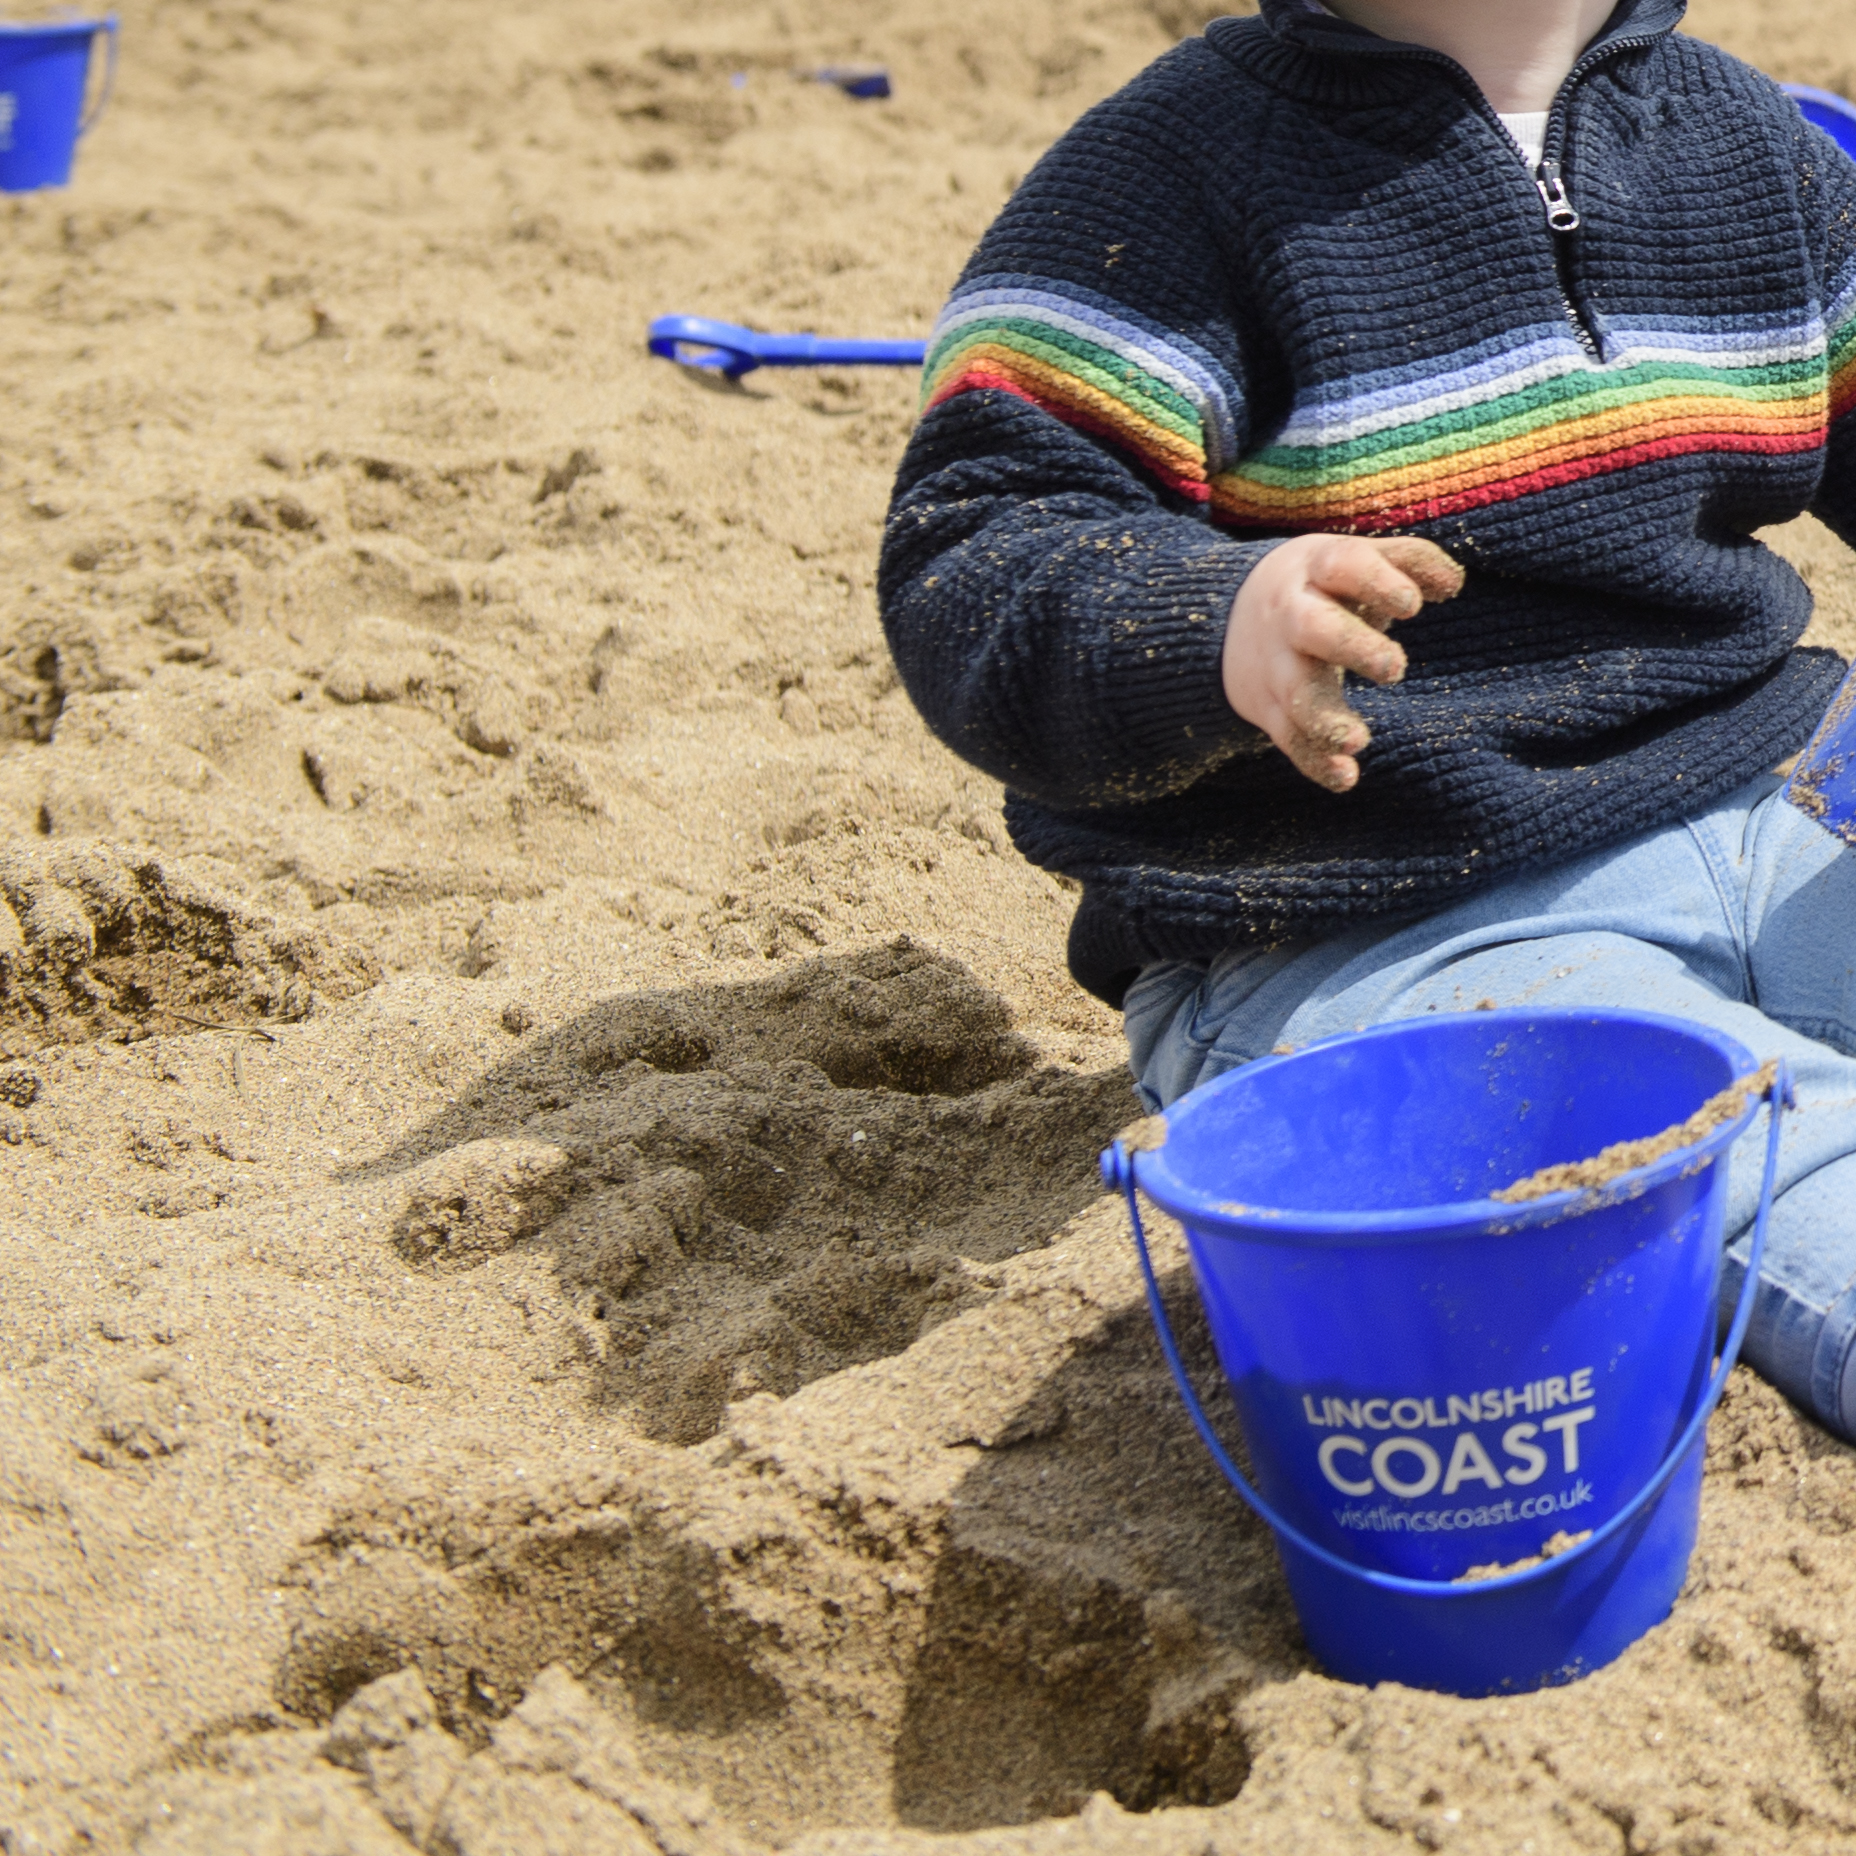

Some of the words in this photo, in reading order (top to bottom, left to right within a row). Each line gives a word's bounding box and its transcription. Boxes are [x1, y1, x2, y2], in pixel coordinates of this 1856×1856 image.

[1302, 1366, 1596, 1430] LINCOLNSHIRE
[1317, 1405, 1596, 1498] COAST
[1333, 1477, 1594, 1532] visitlincscoast.co.uk
